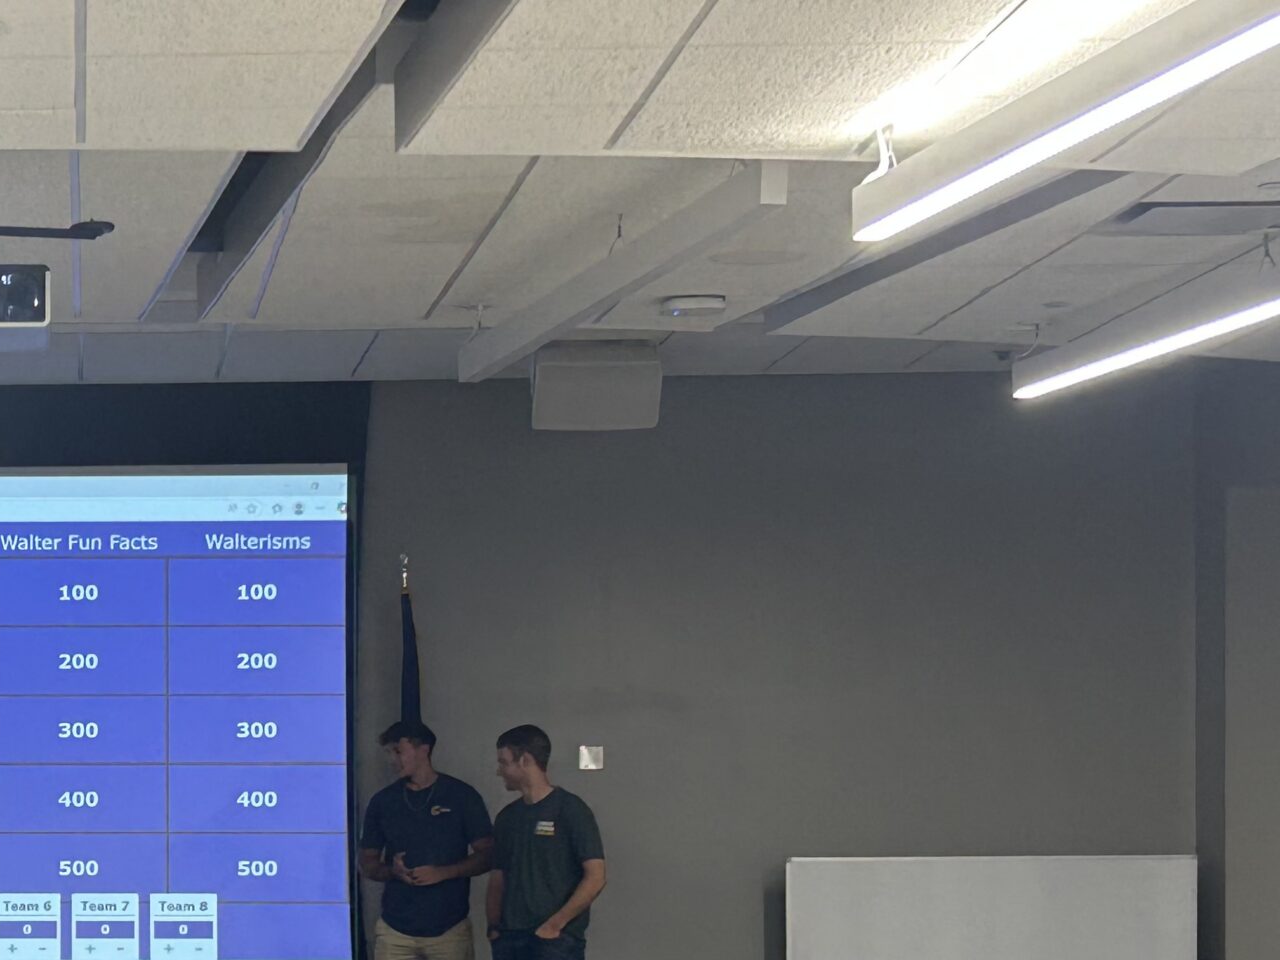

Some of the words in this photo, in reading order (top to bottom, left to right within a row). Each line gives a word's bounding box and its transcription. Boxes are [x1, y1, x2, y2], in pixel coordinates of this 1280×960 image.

[0, 533, 62, 551] Walter
[68, 534, 102, 551] Fun
[110, 534, 159, 551] Facts
[205, 532, 311, 550] Walterisms
[59, 584, 99, 601] 100
[237, 583, 278, 601] 100
[58, 653, 99, 670] 200
[236, 652, 278, 670] 200
[58, 722, 99, 739] 300
[236, 721, 278, 739] 300
[58, 791, 99, 808] 400
[236, 791, 278, 808] 400
[58, 860, 99, 876] 500
[237, 860, 278, 877] 500
[2, 900, 40, 912] Team
[43, 900, 52, 912] 6
[80, 900, 118, 912] Team
[121, 900, 130, 912] 7
[158, 900, 196, 913] Team
[199, 900, 209, 912] 8
[22, 924, 32, 935] 0
[100, 924, 110, 935] 0
[178, 924, 188, 935] 0
